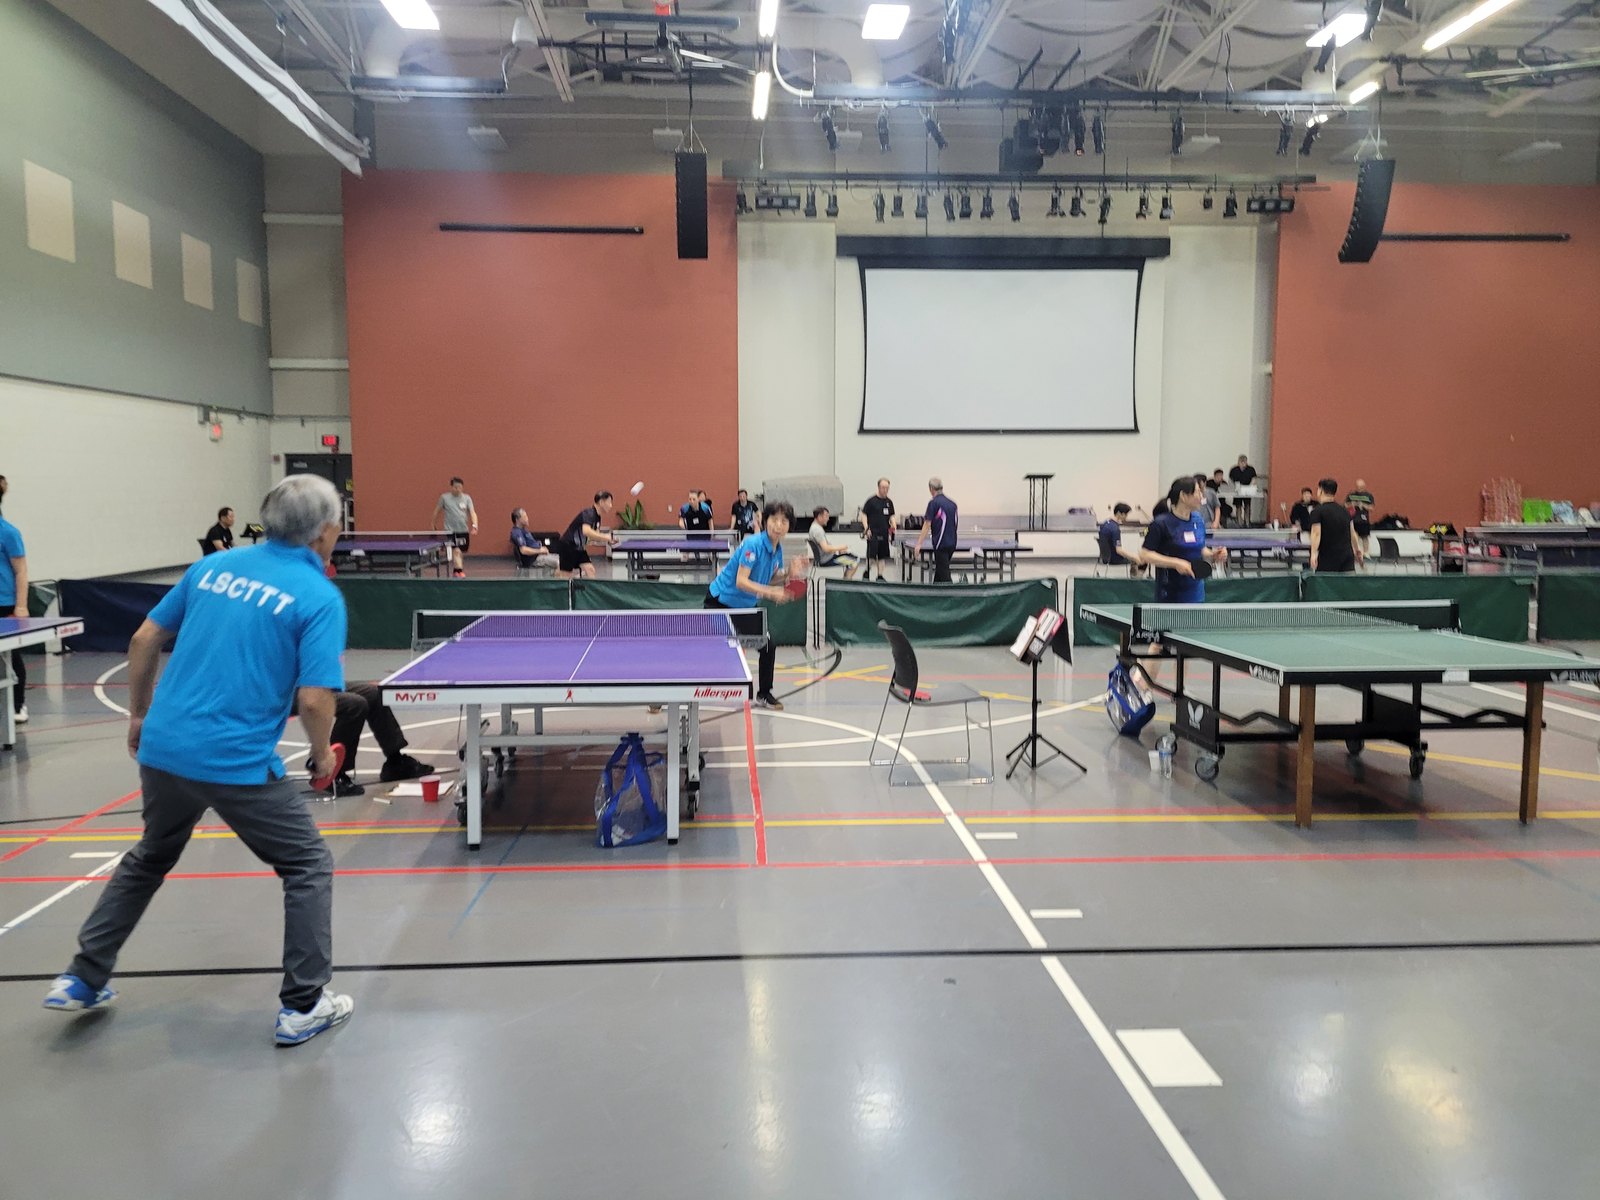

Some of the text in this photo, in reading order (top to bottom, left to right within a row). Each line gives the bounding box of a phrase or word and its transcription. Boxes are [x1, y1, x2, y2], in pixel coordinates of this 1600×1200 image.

[197, 568, 296, 616] LSCTTT
[395, 692, 436, 703] MyT9
[693, 687, 743, 701] killerspin
